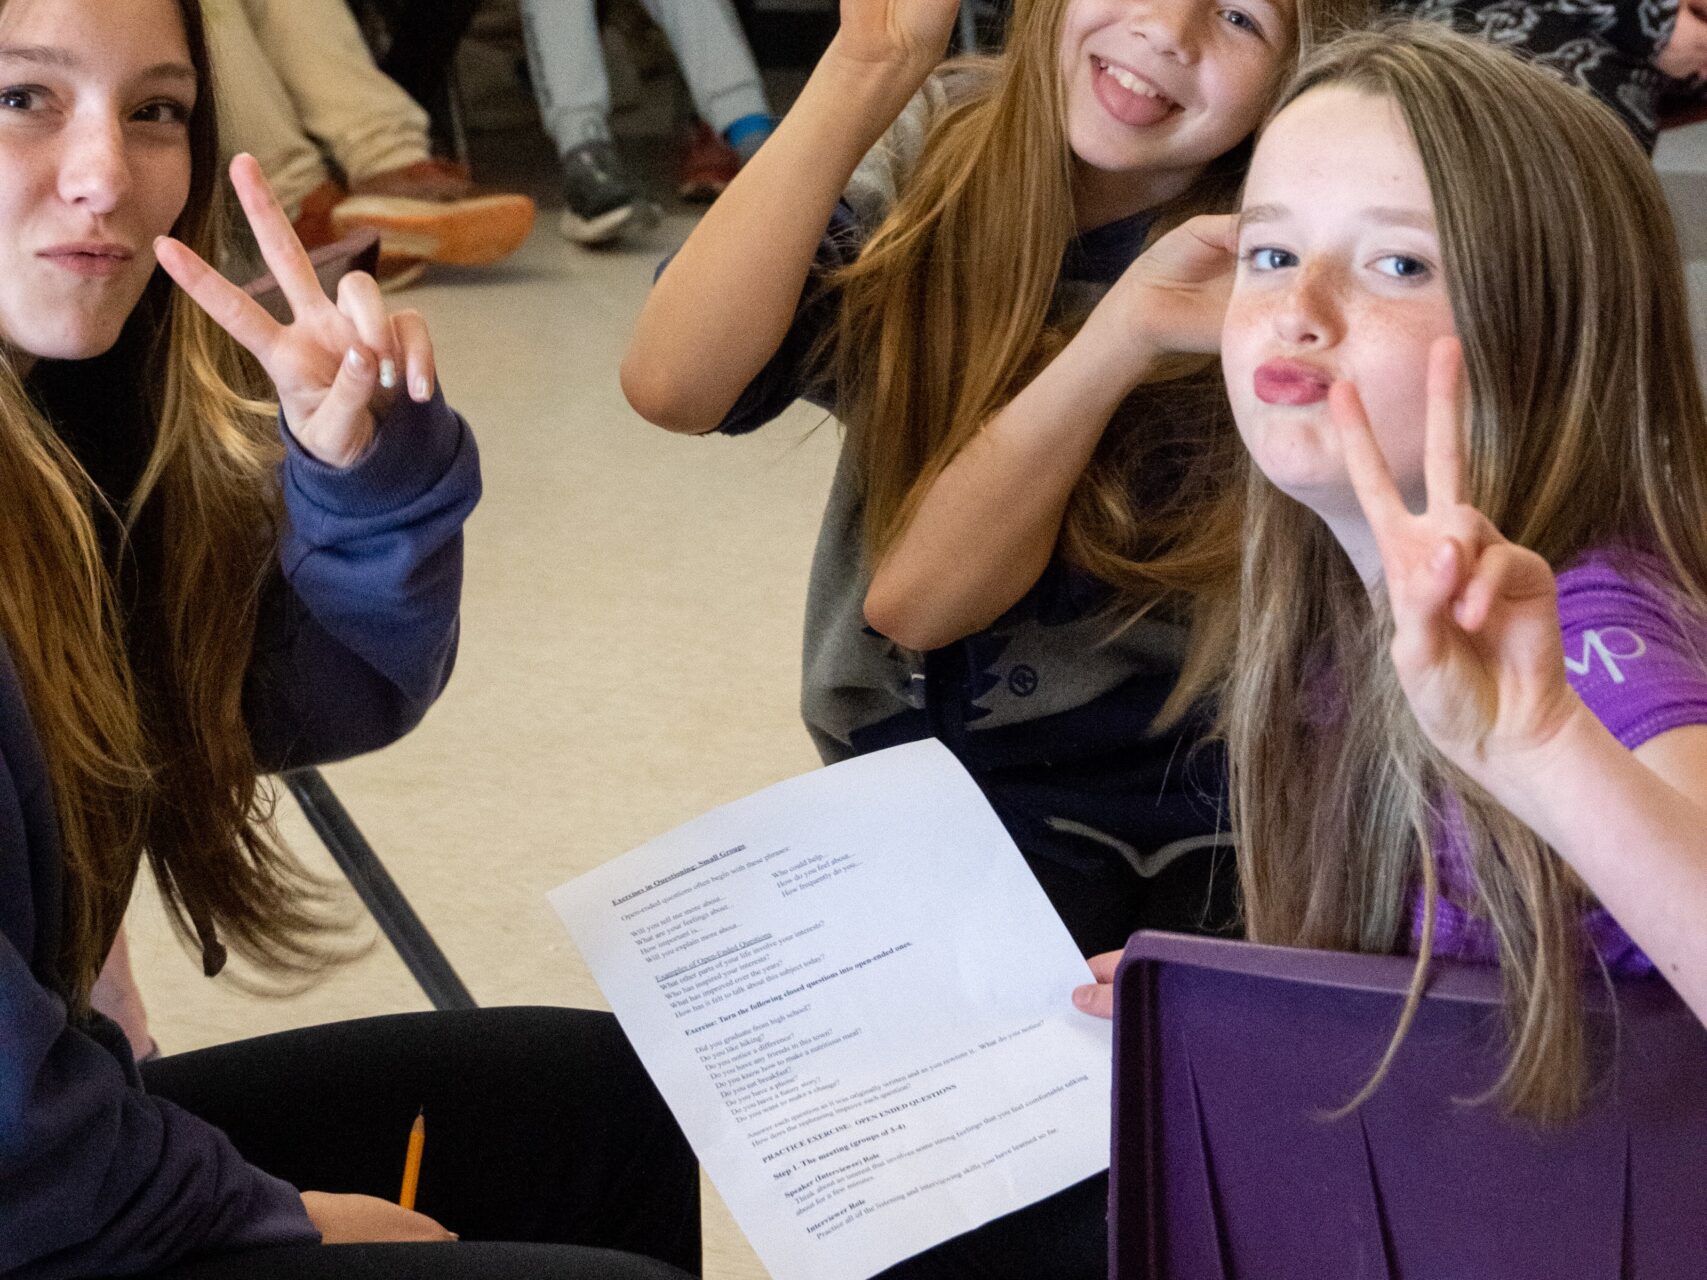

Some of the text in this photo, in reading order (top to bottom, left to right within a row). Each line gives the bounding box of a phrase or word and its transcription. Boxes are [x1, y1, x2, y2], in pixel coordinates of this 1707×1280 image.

[611, 888, 646, 907] Exercises
[697, 853, 720, 868] Small
[718, 843, 747, 859] Groups
[717, 1012, 737, 1023] Turn
[736, 1007, 749, 1016] the
[749, 994, 784, 1011] following
[783, 983, 805, 997] closed
[805, 972, 839, 989] questions
[838, 965, 854, 975] into
[854, 947, 894, 969] open-ended
